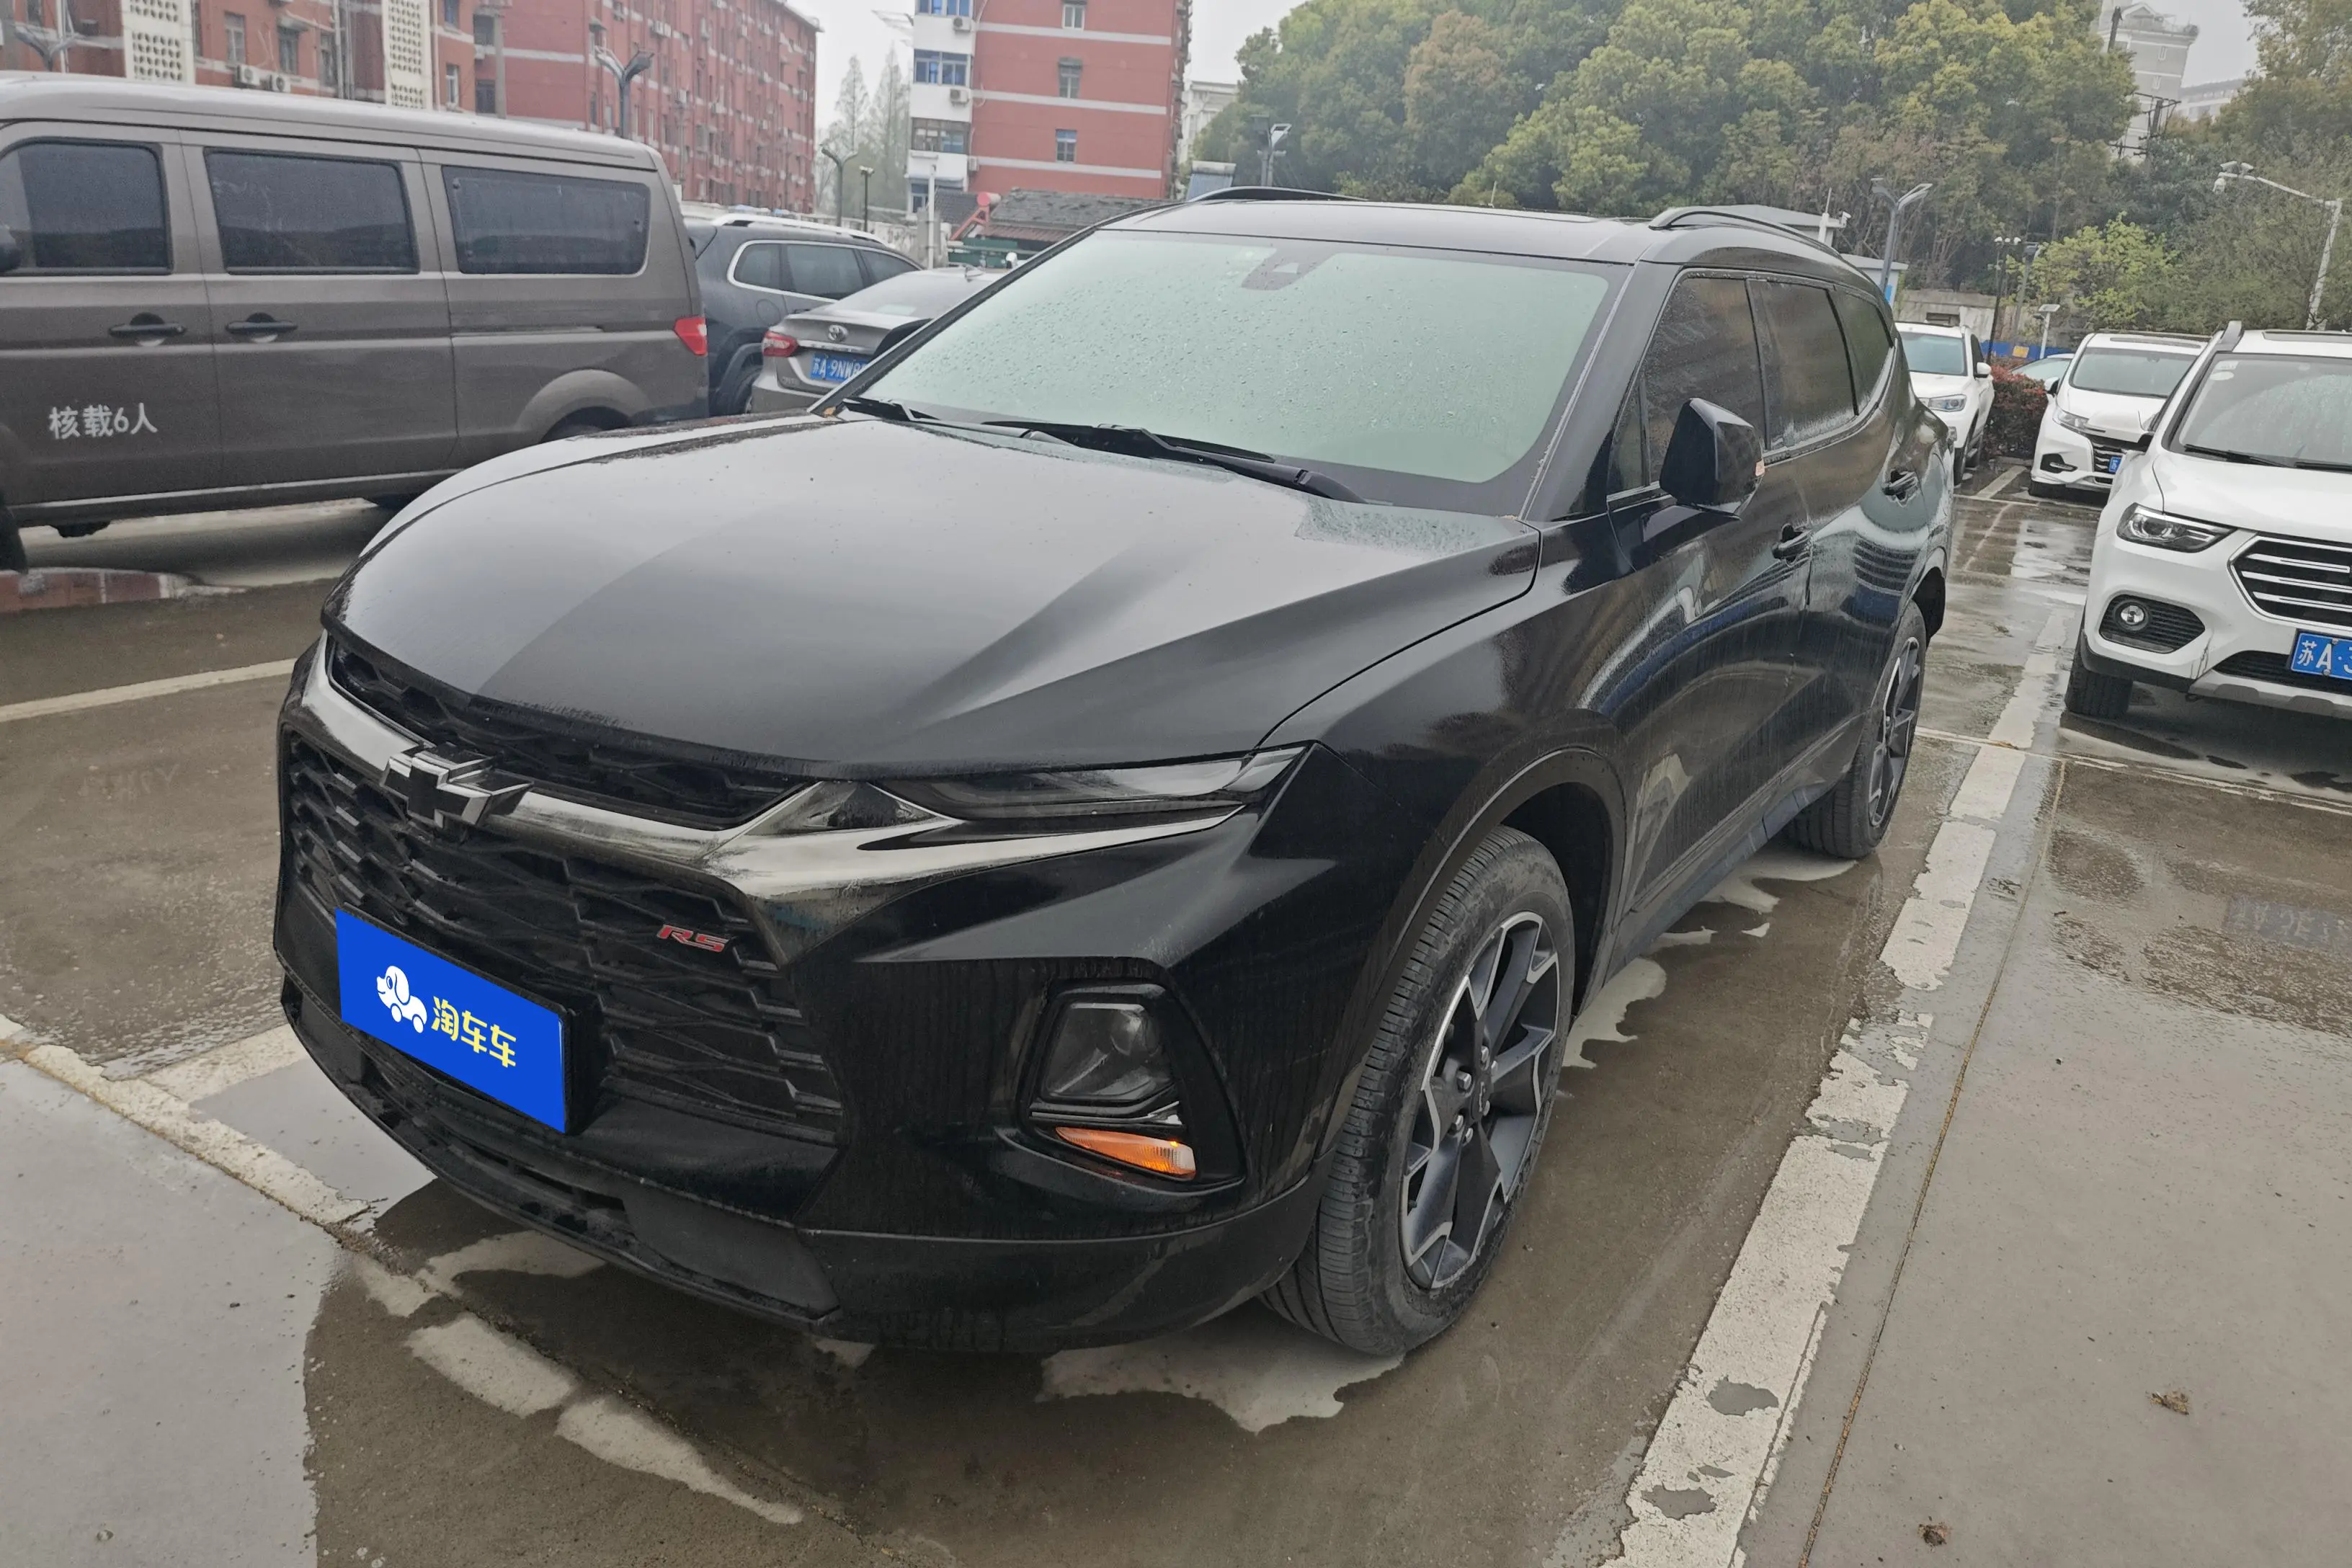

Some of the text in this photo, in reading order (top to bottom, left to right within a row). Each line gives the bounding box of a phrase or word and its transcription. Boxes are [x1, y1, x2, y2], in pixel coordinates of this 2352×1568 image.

[48, 402, 158, 440] 核载6人
[656, 925, 729, 952] RS
